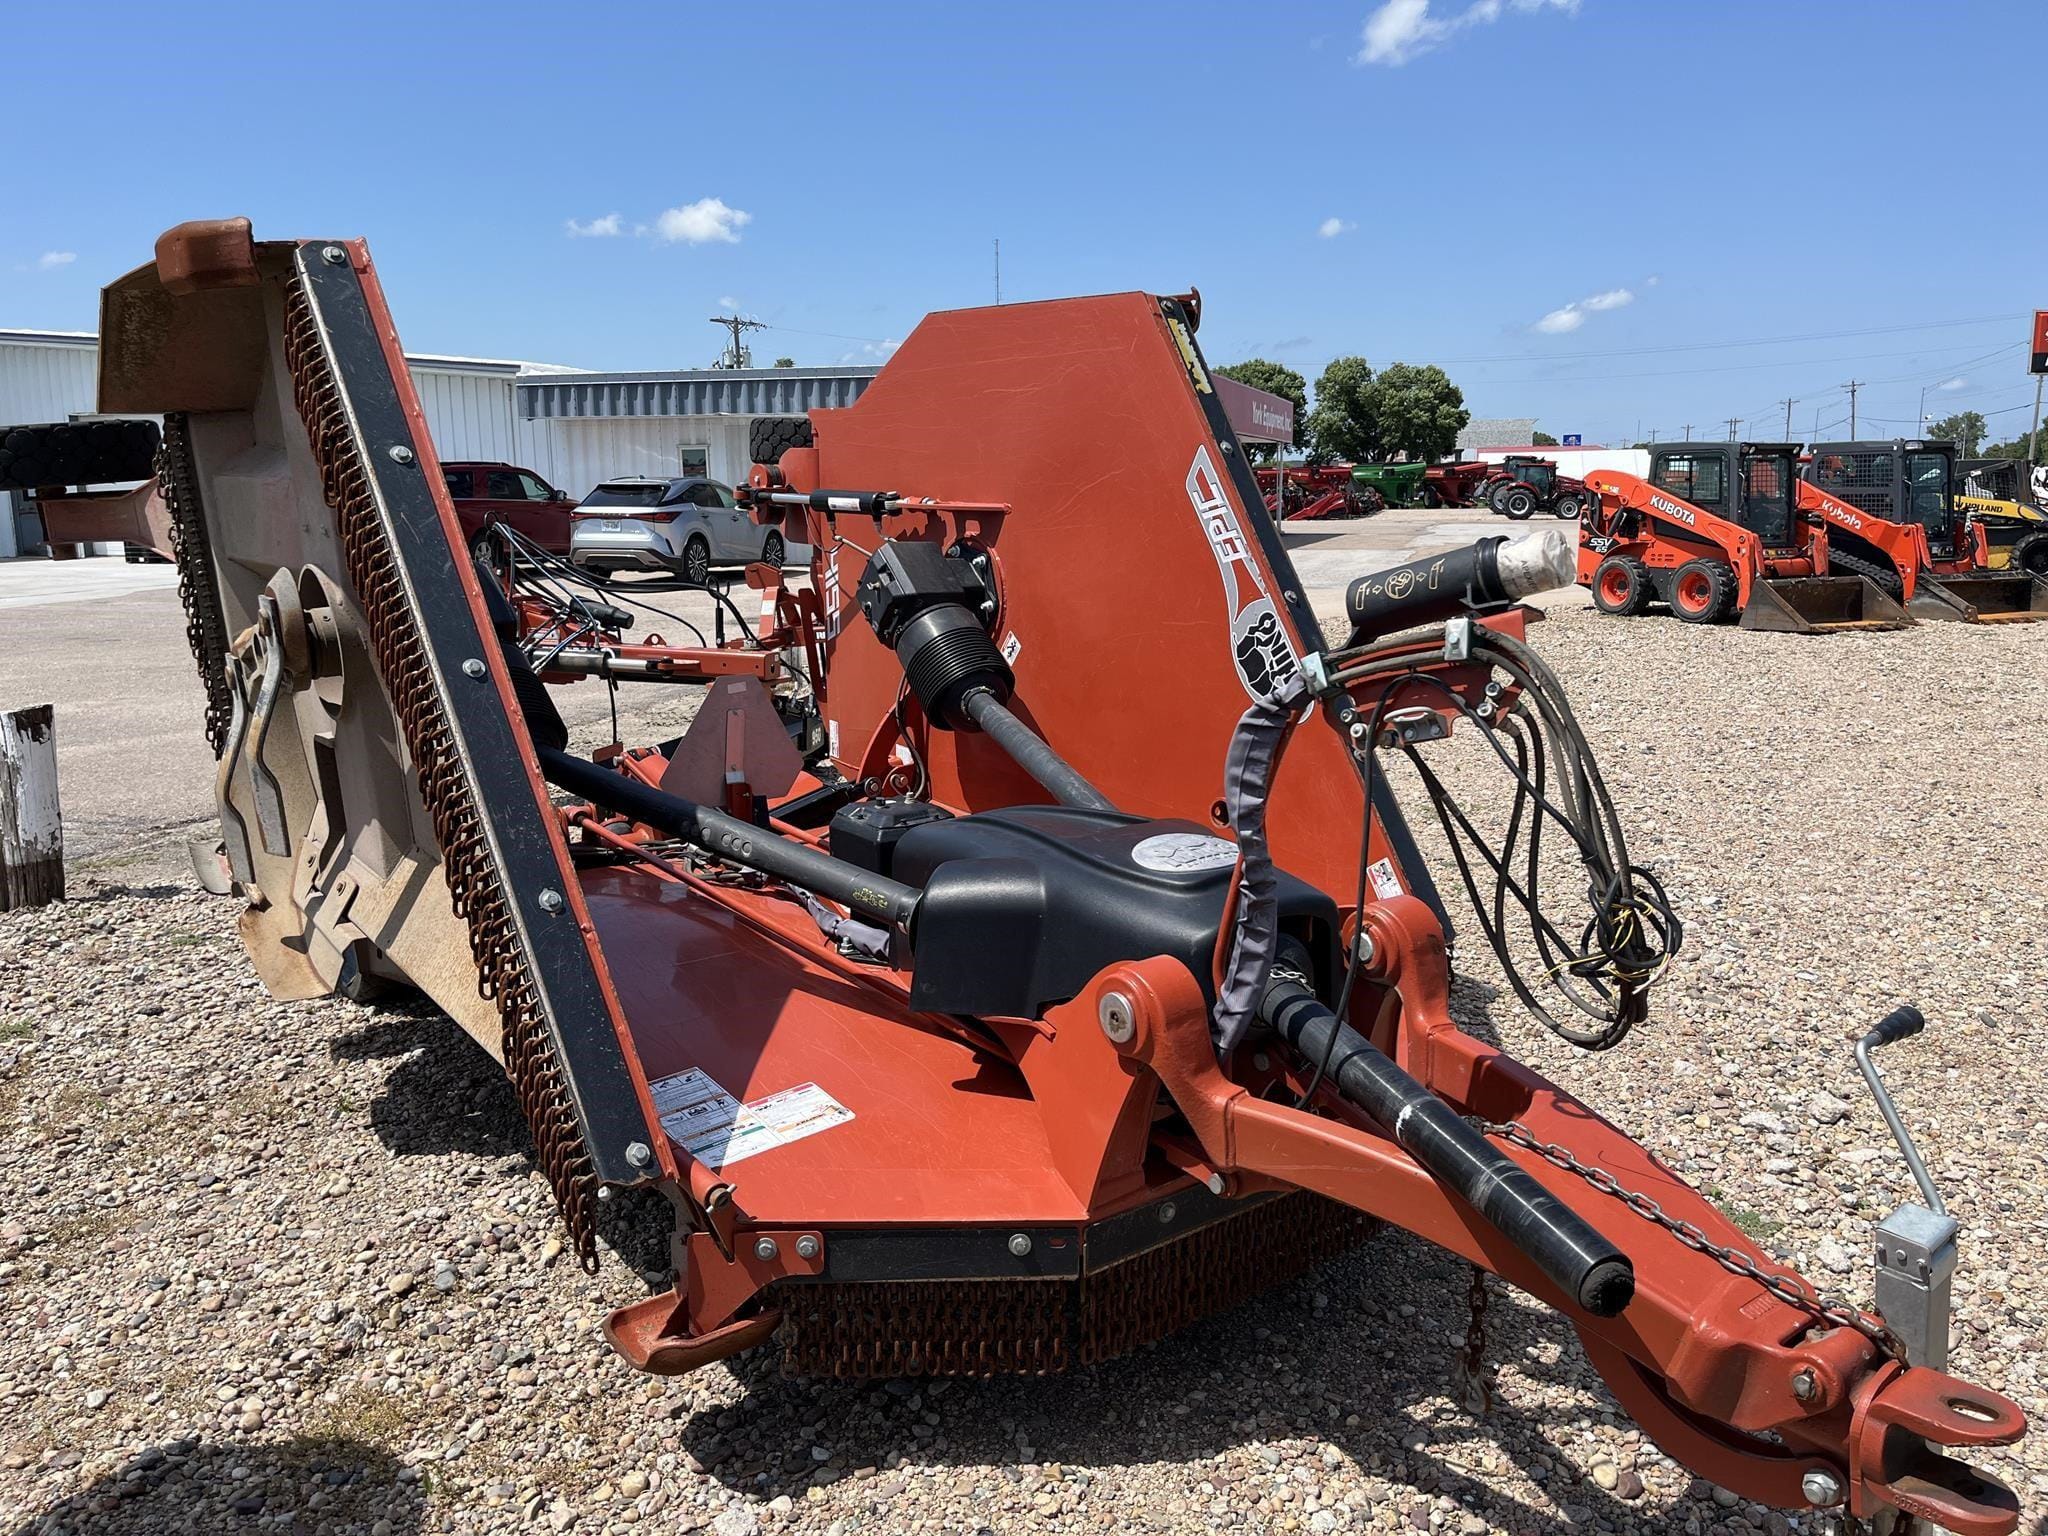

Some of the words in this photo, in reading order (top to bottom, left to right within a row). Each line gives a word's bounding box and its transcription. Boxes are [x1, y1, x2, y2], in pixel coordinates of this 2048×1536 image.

[1192, 483, 1249, 564] EPIC
[1650, 494, 1696, 526] KUBOTA
[1822, 499, 1862, 530] Kubota
[1589, 537, 1613, 547] SSV
